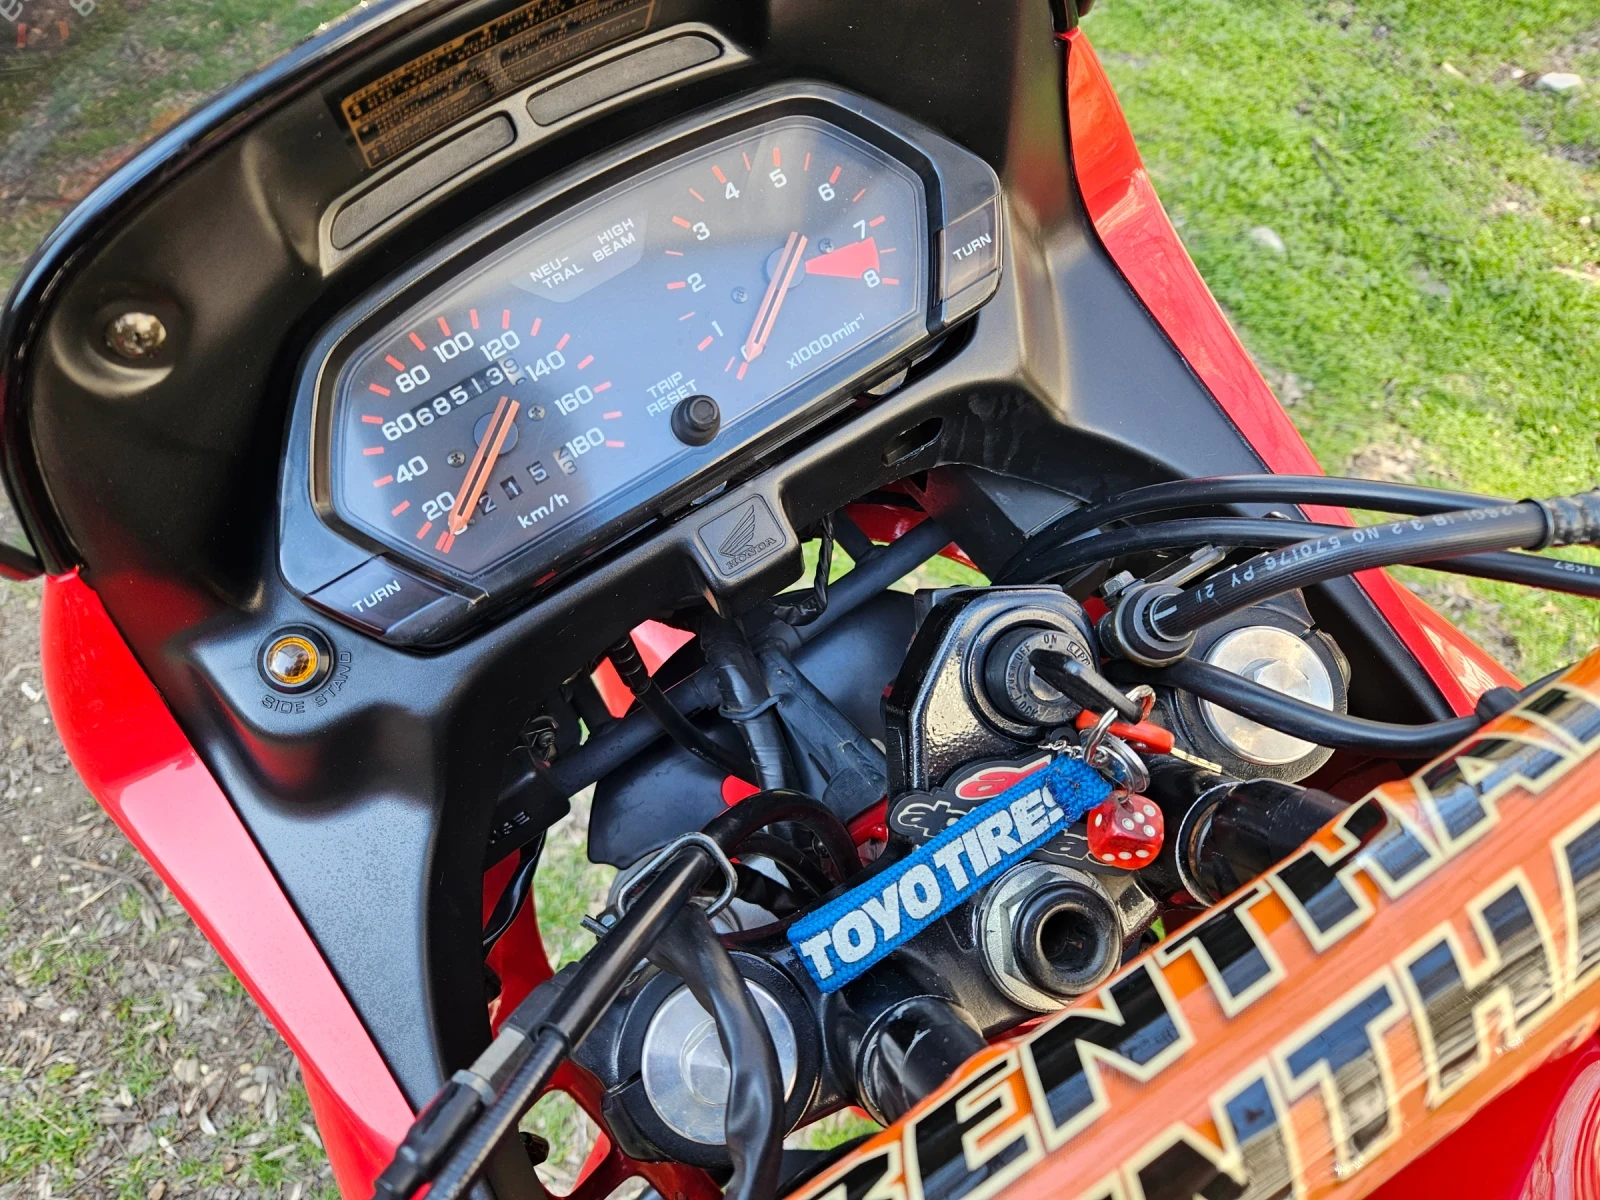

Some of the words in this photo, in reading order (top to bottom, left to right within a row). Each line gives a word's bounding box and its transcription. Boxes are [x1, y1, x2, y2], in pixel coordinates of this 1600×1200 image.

[725, 182, 741, 200] 4
[769, 168, 787, 188] 5
[818, 184, 835, 201] 6
[597, 218, 635, 246] HIGH
[693, 222, 710, 240] 3
[853, 220, 867, 238] 7
[592, 233, 636, 263] BEAM
[953, 233, 992, 261] TURN
[529, 255, 570, 283] NEU-
[542, 263, 583, 290] TRAL
[687, 273, 706, 292] 2
[863, 270, 881, 288] 8
[711, 320, 724, 336] 1
[433, 331, 474, 363] 100
[480, 330, 521, 362] 120
[395, 364, 431, 394] 80
[525, 350, 566, 382] 140
[646, 371, 683, 398] TRIP
[646, 379, 698, 417] RESET
[554, 384, 594, 416] 160
[381, 412, 418, 441] 60
[565, 426, 605, 458] 180
[396, 455, 429, 483] 40
[421, 491, 456, 521] 20
[517, 493, 569, 529] km/h
[1391, 517, 1424, 535] 3.2
[725, 537, 777, 570] HONDA
[1265, 536, 1342, 570] 570176
[1230, 565, 1255, 588] PY
[352, 580, 401, 614] TURN
[1013, 642, 1031, 661] OFF
[1043, 634, 1058, 644] ON
[261, 694, 306, 715] SIDE
[315, 650, 352, 708] STAND
[1007, 664, 1017, 691] PUSH
[1011, 694, 1039, 719] LOCK
[800, 864, 942, 980] TOYO
